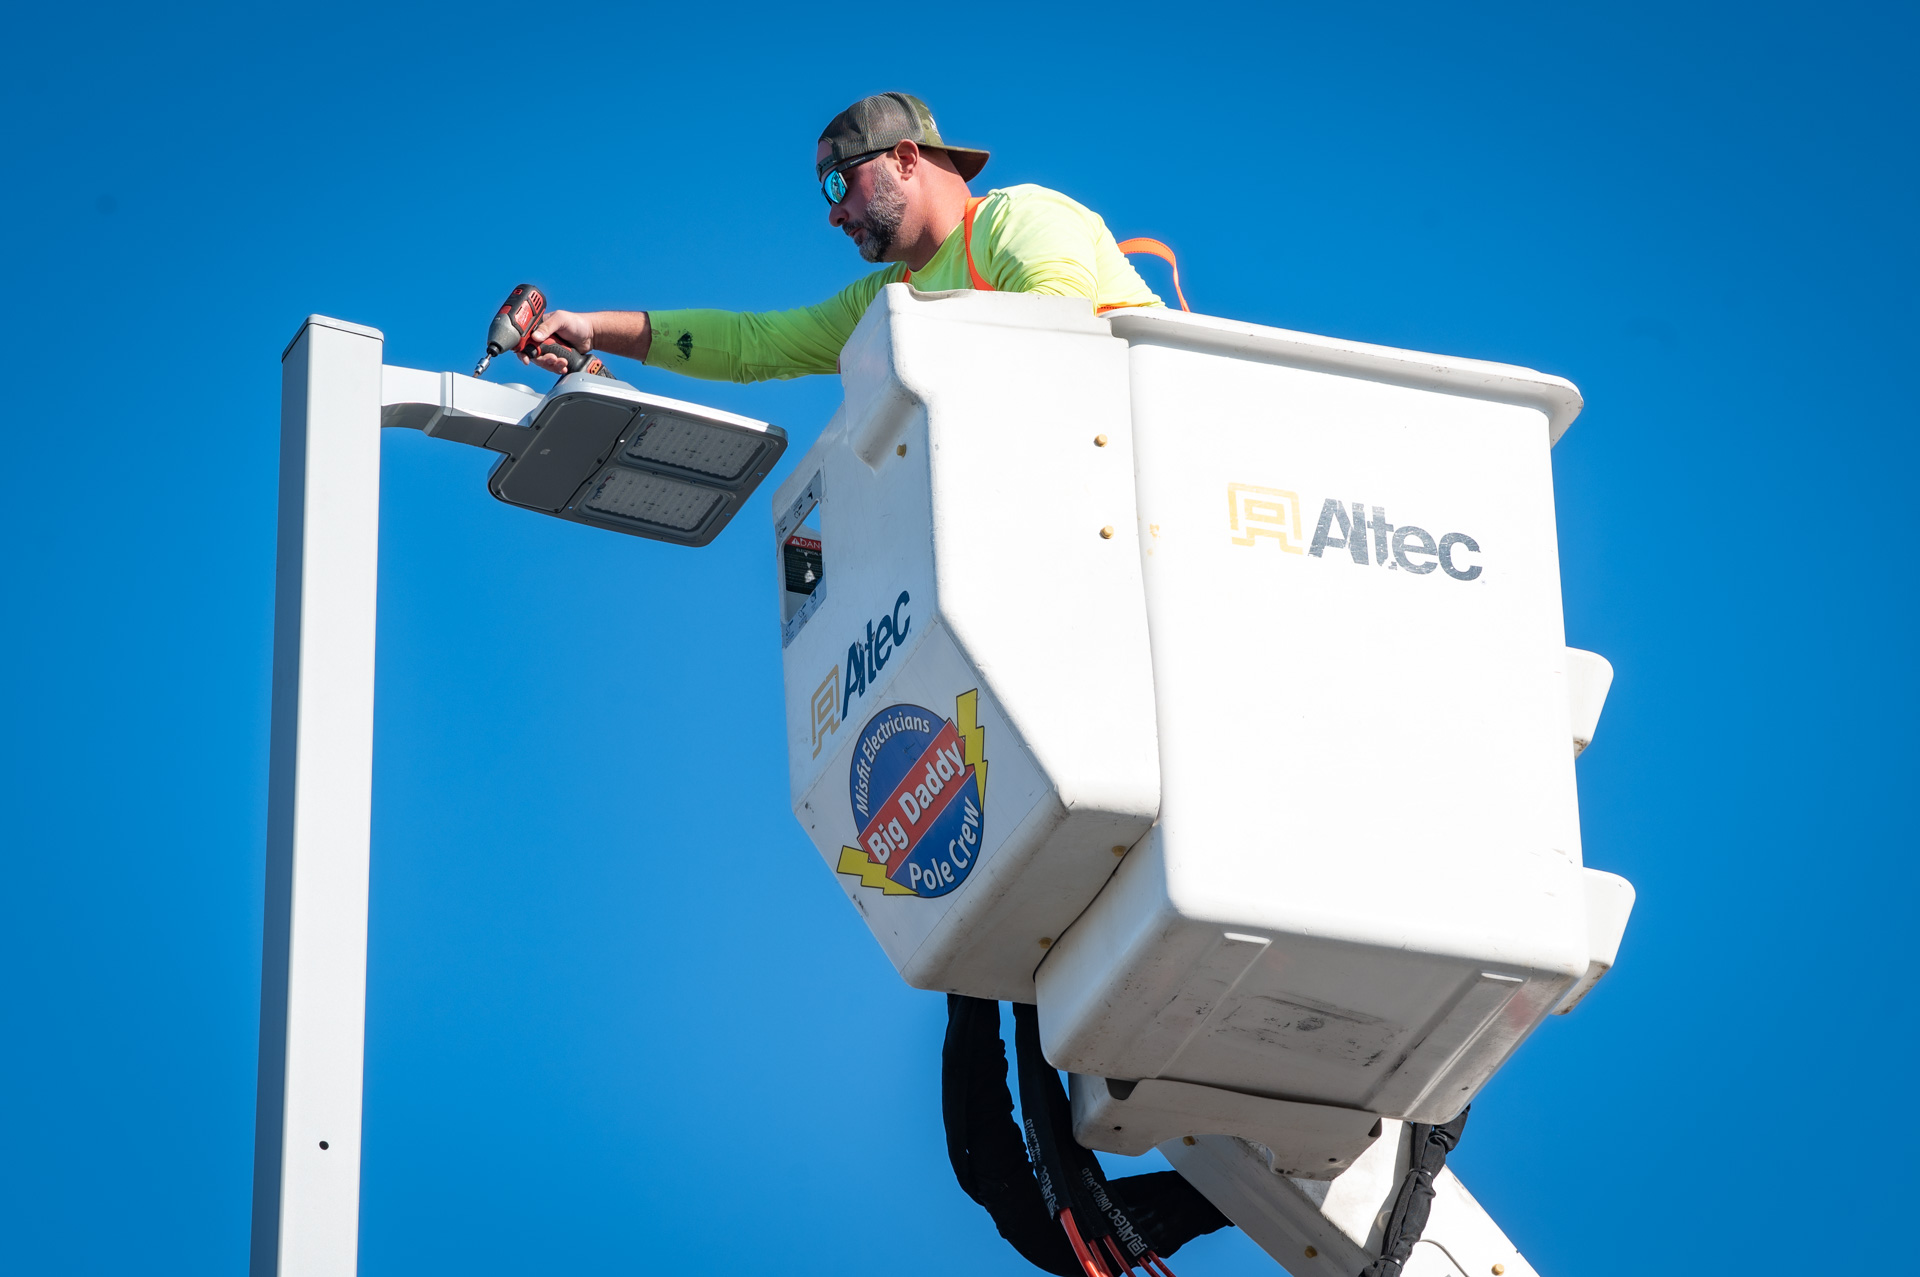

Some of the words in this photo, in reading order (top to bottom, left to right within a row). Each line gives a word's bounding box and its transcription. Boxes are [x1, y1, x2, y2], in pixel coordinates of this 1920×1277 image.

[800, 538, 822, 549] DAN
[1307, 498, 1484, 582] Altec
[842, 590, 911, 721] Altec
[862, 712, 931, 758] Electricians
[856, 762, 873, 818] Misfit
[867, 818, 909, 865] Big
[898, 740, 966, 826] Daddy
[908, 861, 955, 891] Pole
[948, 796, 981, 868] Crew
[1041, 1165, 1056, 1200] Altec
[1108, 1208, 1140, 1242] Altec
